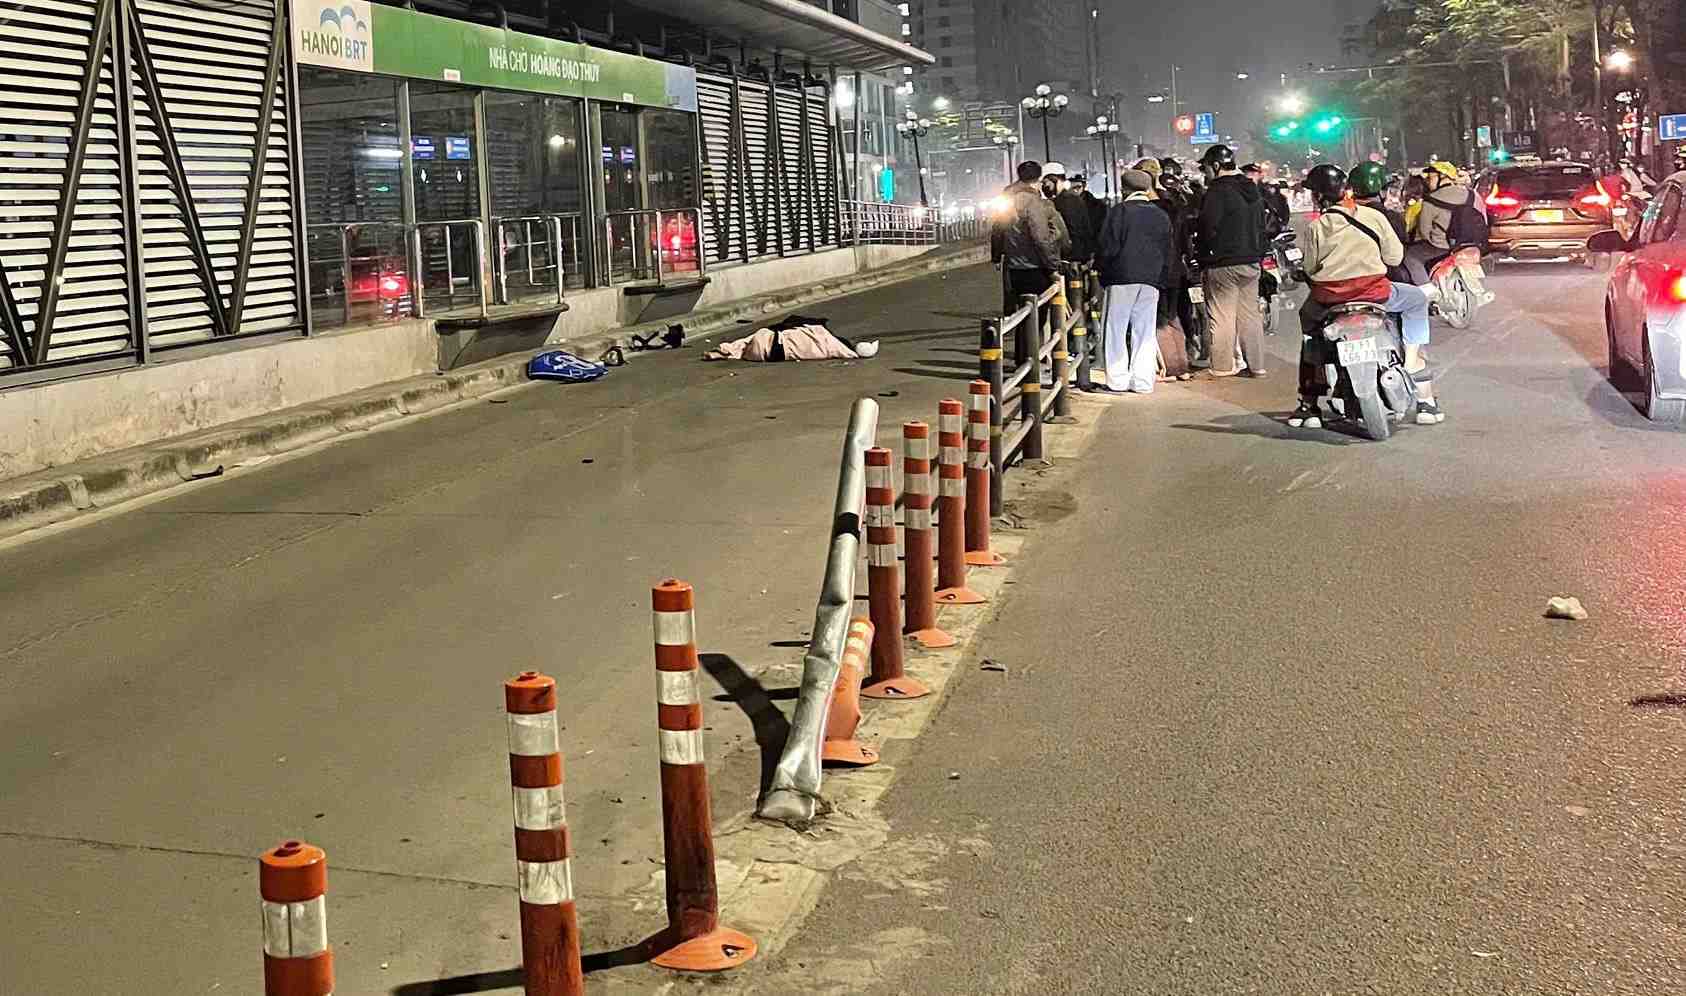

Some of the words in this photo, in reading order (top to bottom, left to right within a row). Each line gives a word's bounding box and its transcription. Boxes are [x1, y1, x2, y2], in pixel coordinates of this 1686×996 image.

[301, 29, 343, 58] HANOI
[345, 37, 367, 61] BRT
[488, 44, 508, 70] NHÀ
[509, 47, 528, 73] CHỜ
[530, 51, 560, 77] HOÀNG
[560, 58, 579, 85] ĐẠO
